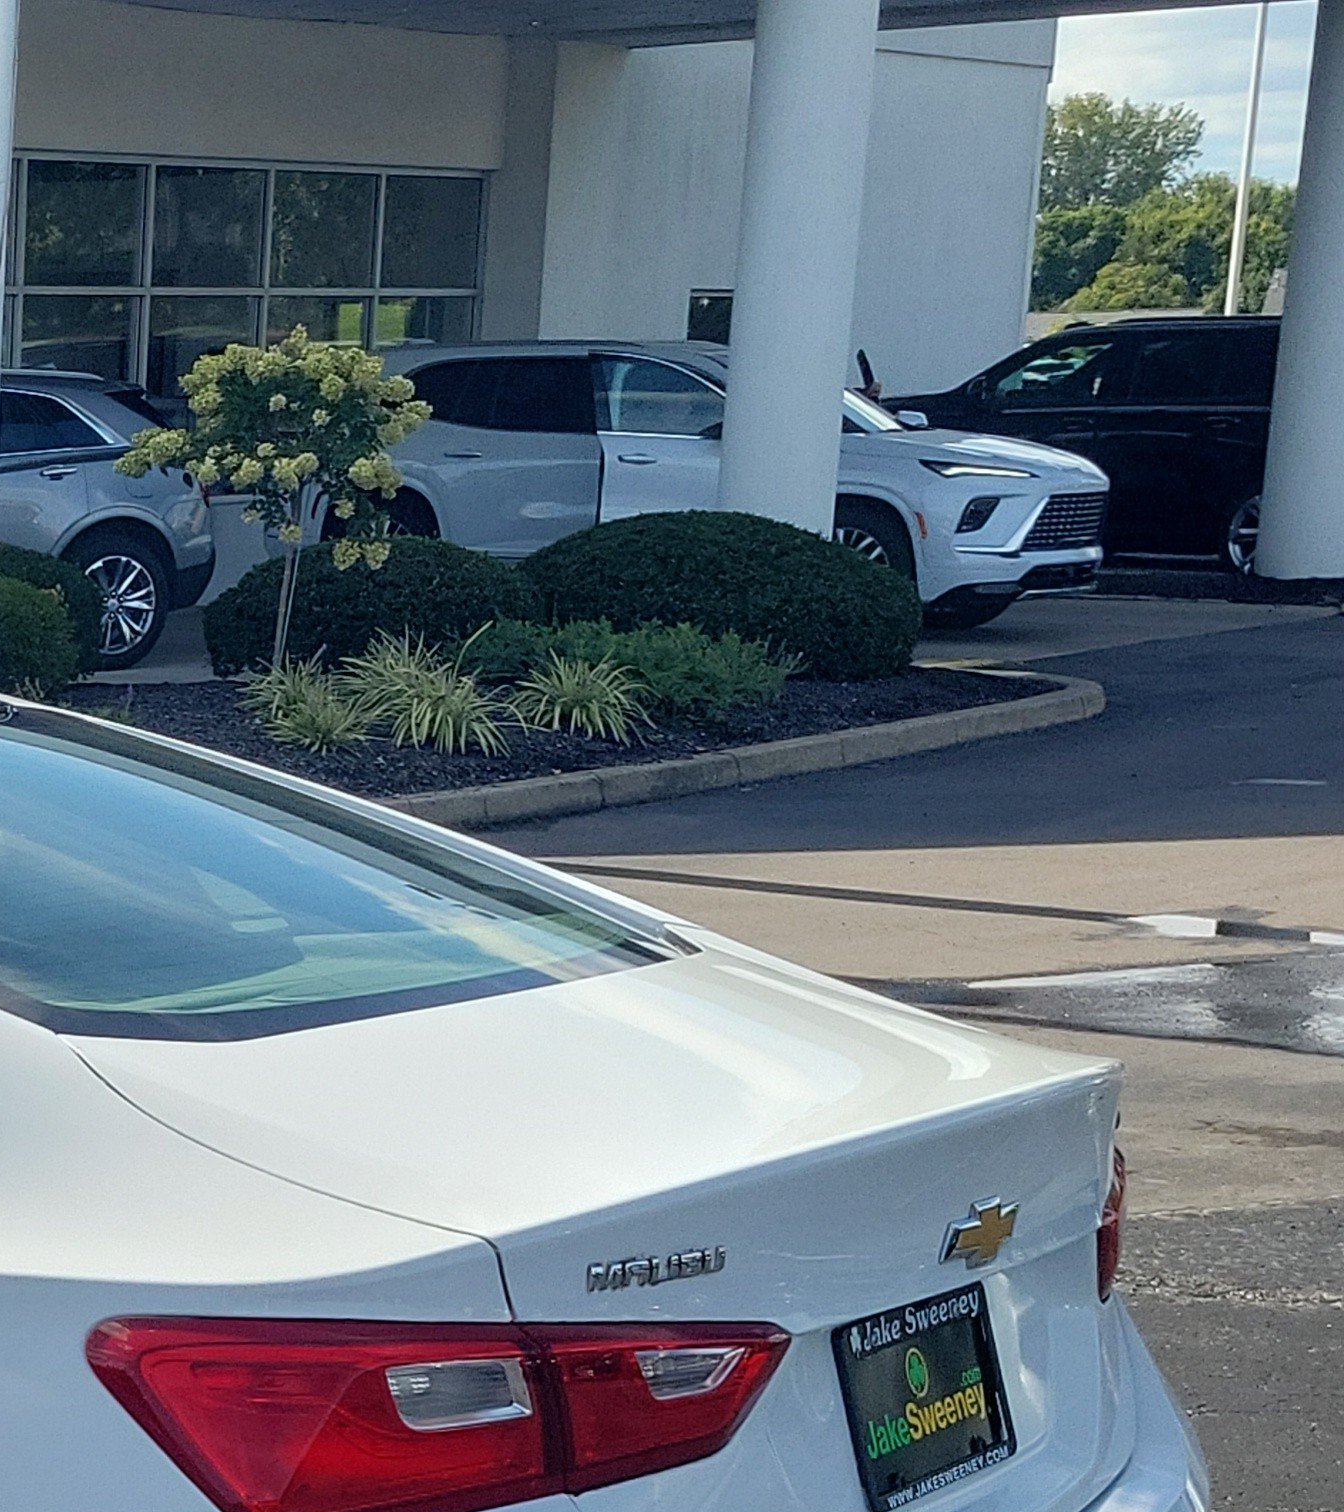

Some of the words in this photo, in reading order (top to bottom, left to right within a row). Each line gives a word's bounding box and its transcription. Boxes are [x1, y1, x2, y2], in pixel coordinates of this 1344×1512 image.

[586, 1245, 727, 1293] MALIBU
[863, 1317, 902, 1351] Jake
[904, 1289, 980, 1335] Sweeney
[960, 1366, 982, 1386] .com
[867, 1383, 986, 1460] JakeSweeney
[887, 1445, 1009, 1509] WWW.JAKESWEENEY.COM
